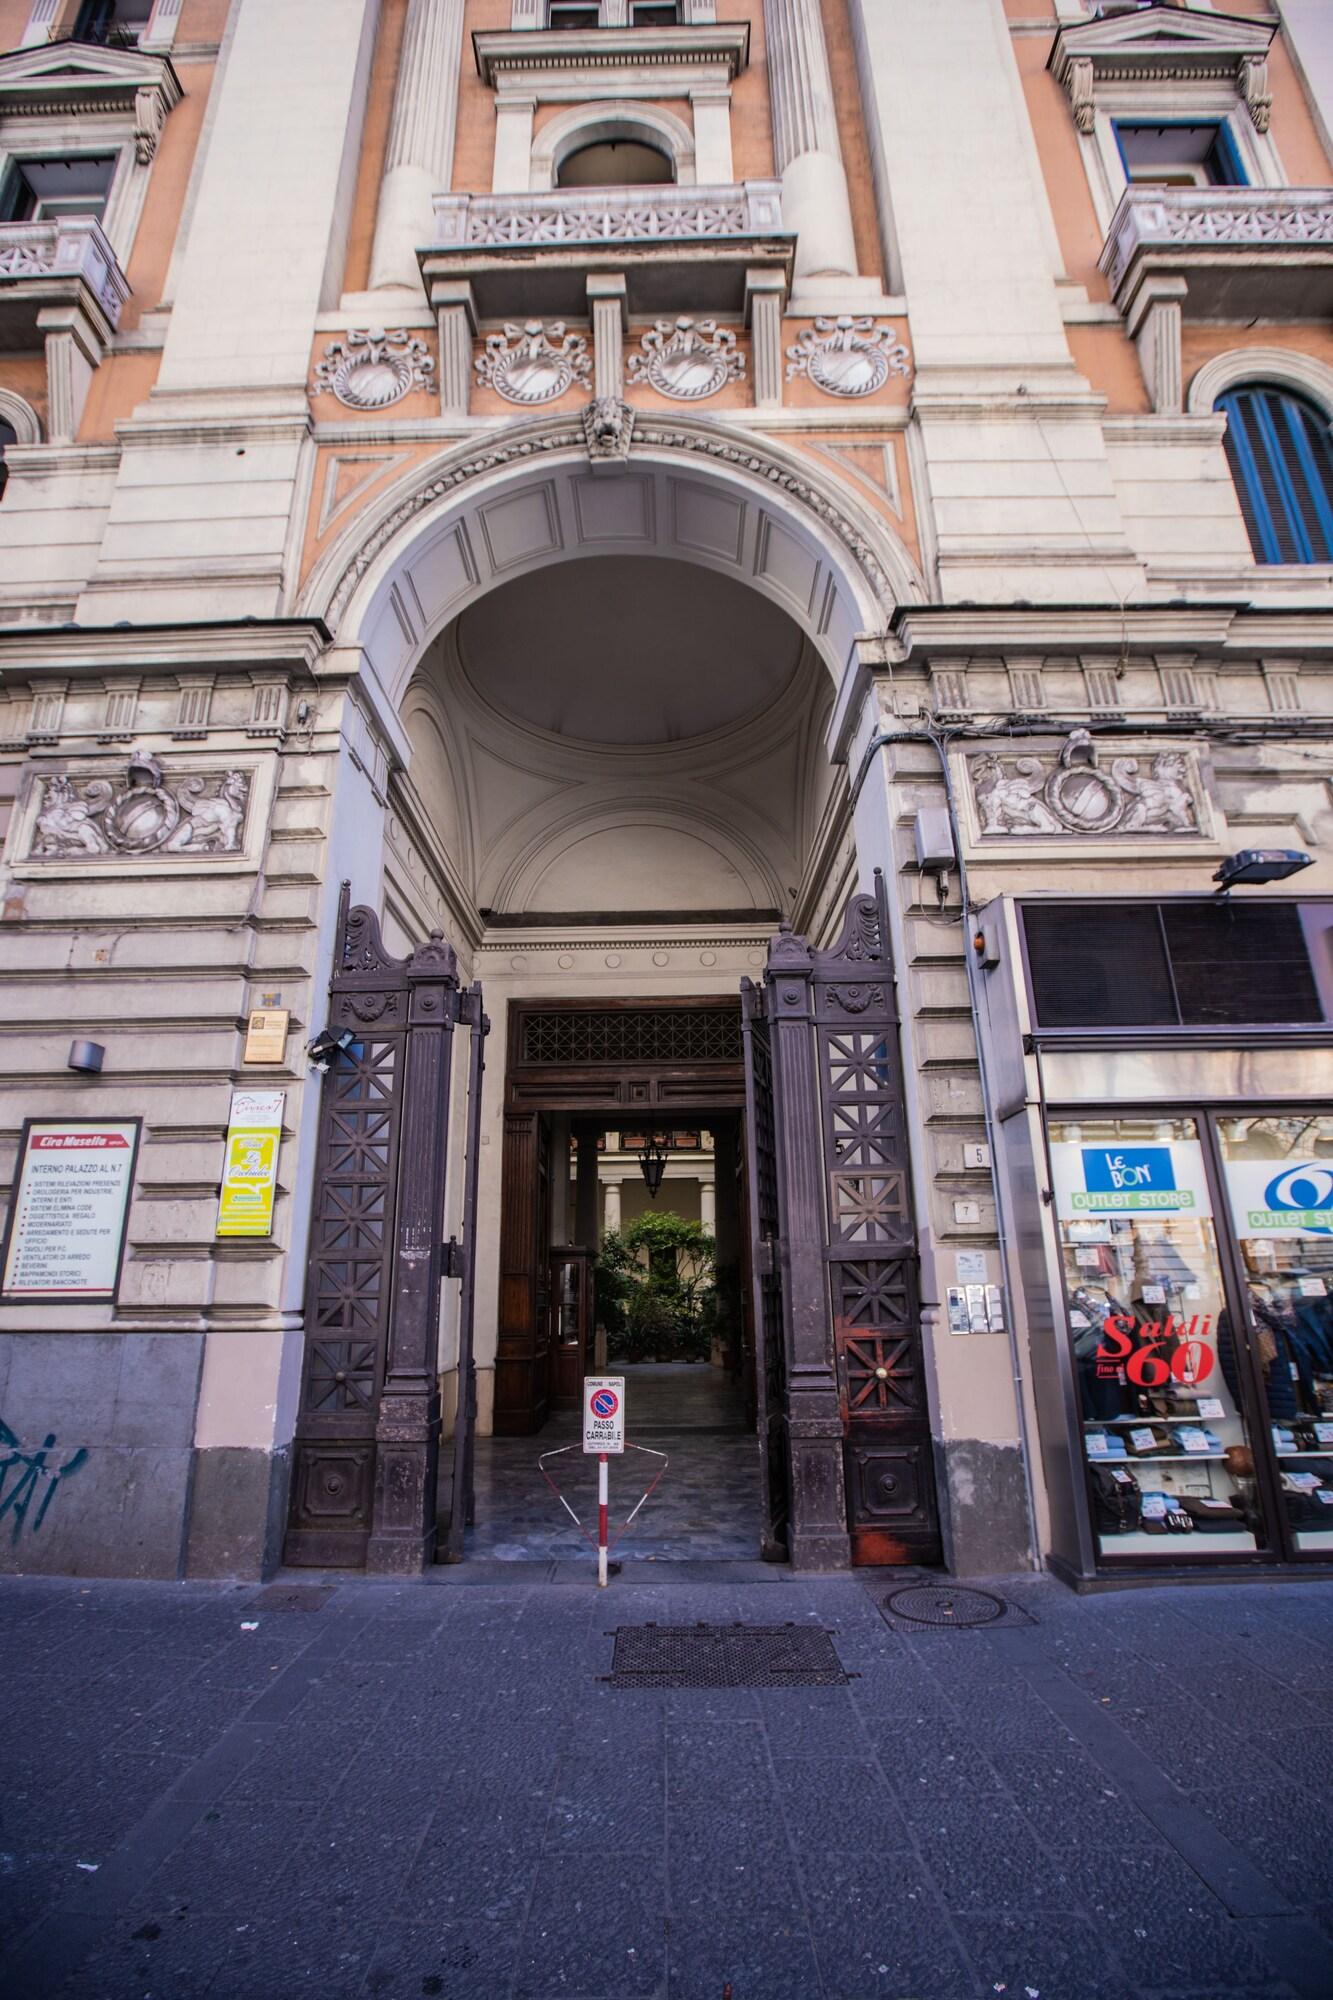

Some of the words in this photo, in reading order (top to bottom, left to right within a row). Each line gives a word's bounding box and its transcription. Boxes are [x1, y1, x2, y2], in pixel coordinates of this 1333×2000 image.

[40, 1137, 61, 1147] Ciro
[62, 1135, 107, 1147] Musella
[976, 1148, 983, 1163] 5
[1105, 1153, 1126, 1170] LE
[32, 1165, 63, 1173] INTERNO
[65, 1164, 98, 1173] PALAZZO
[100, 1164, 108, 1172] AL
[1111, 1164, 1153, 1188] BON
[964, 1206, 969, 1216] 7
[1096, 1313, 1213, 1358] Saldi
[1097, 1364, 1114, 1376] fino
[1126, 1341, 1215, 1387] 60
[594, 1421, 614, 1430] PASSO
[586, 1431, 621, 1440] CARRABILE
